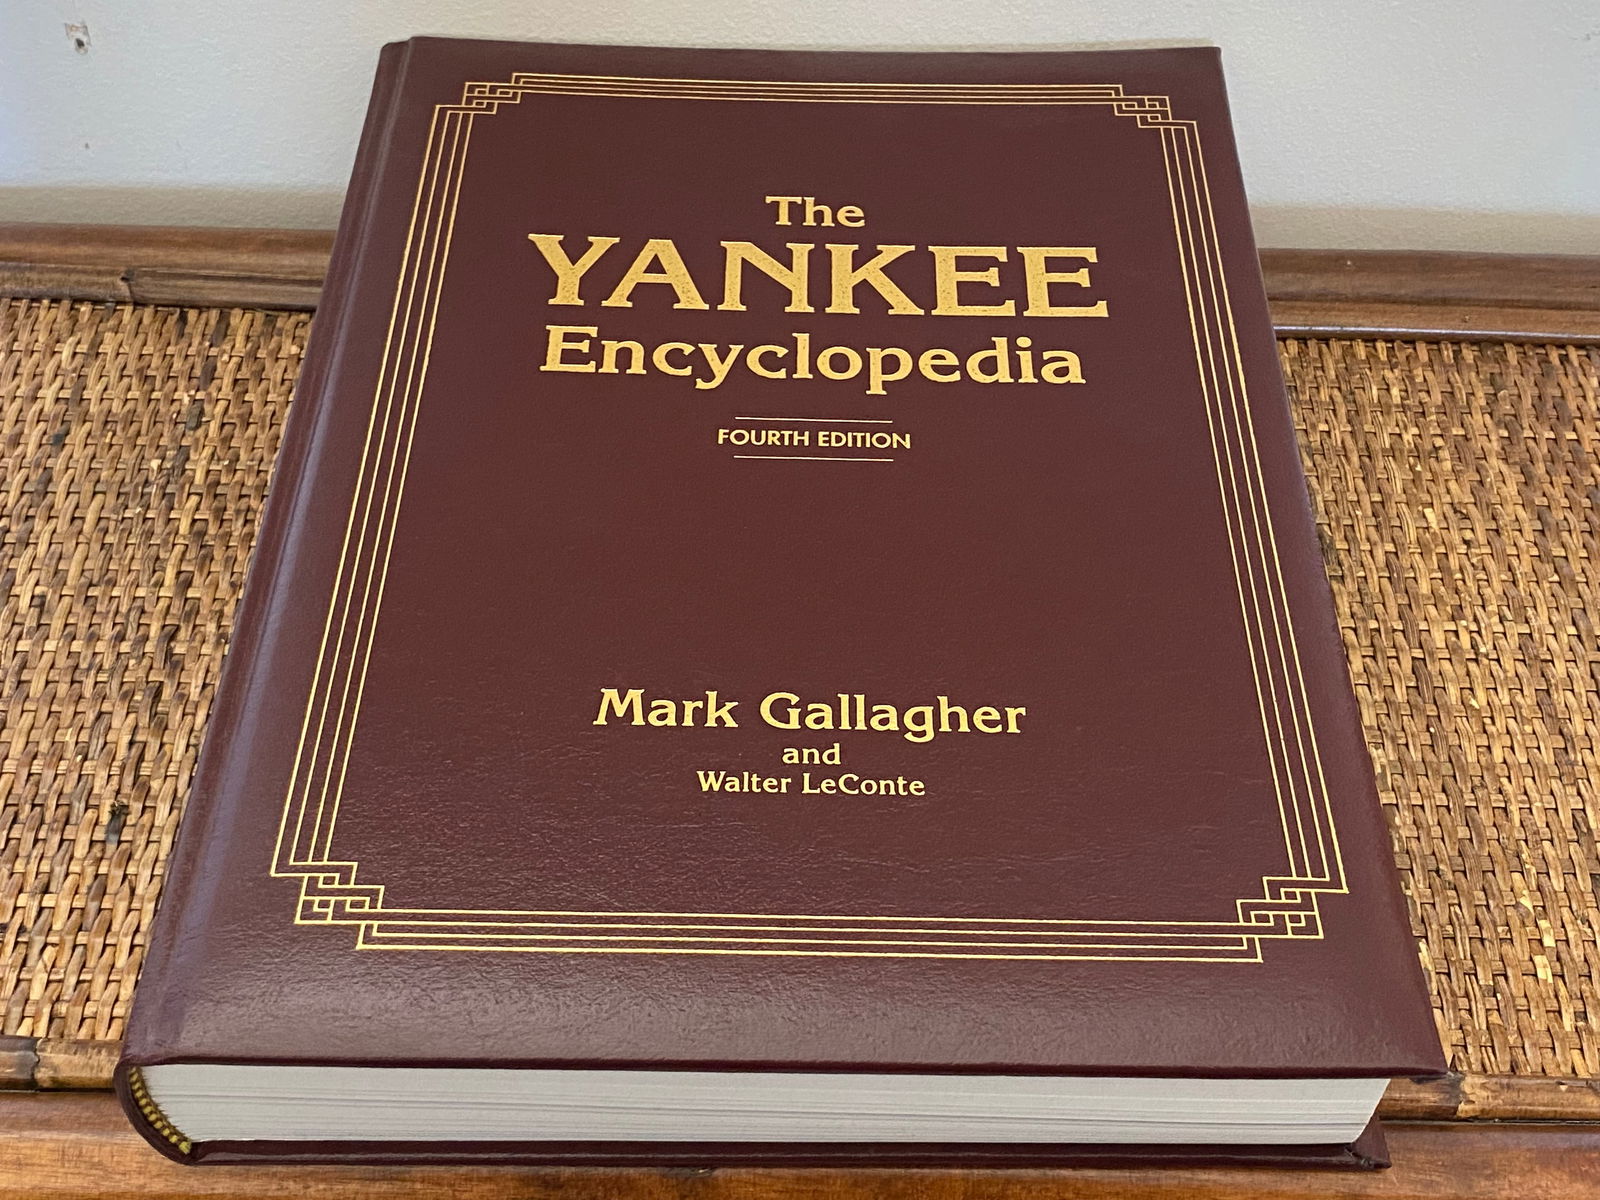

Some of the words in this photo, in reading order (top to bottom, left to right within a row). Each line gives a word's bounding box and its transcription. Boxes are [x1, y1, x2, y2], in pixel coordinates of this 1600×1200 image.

[765, 195, 866, 228] The
[527, 233, 1110, 319] YANKEE
[539, 324, 1087, 396] Encyclopedia
[717, 428, 810, 448] FOURTH
[817, 430, 912, 450] EDITION
[592, 687, 740, 729] Mark
[759, 691, 1027, 743] Gallagher
[781, 742, 842, 765] and
[696, 770, 793, 794] Walter
[801, 772, 926, 797] LeConte
